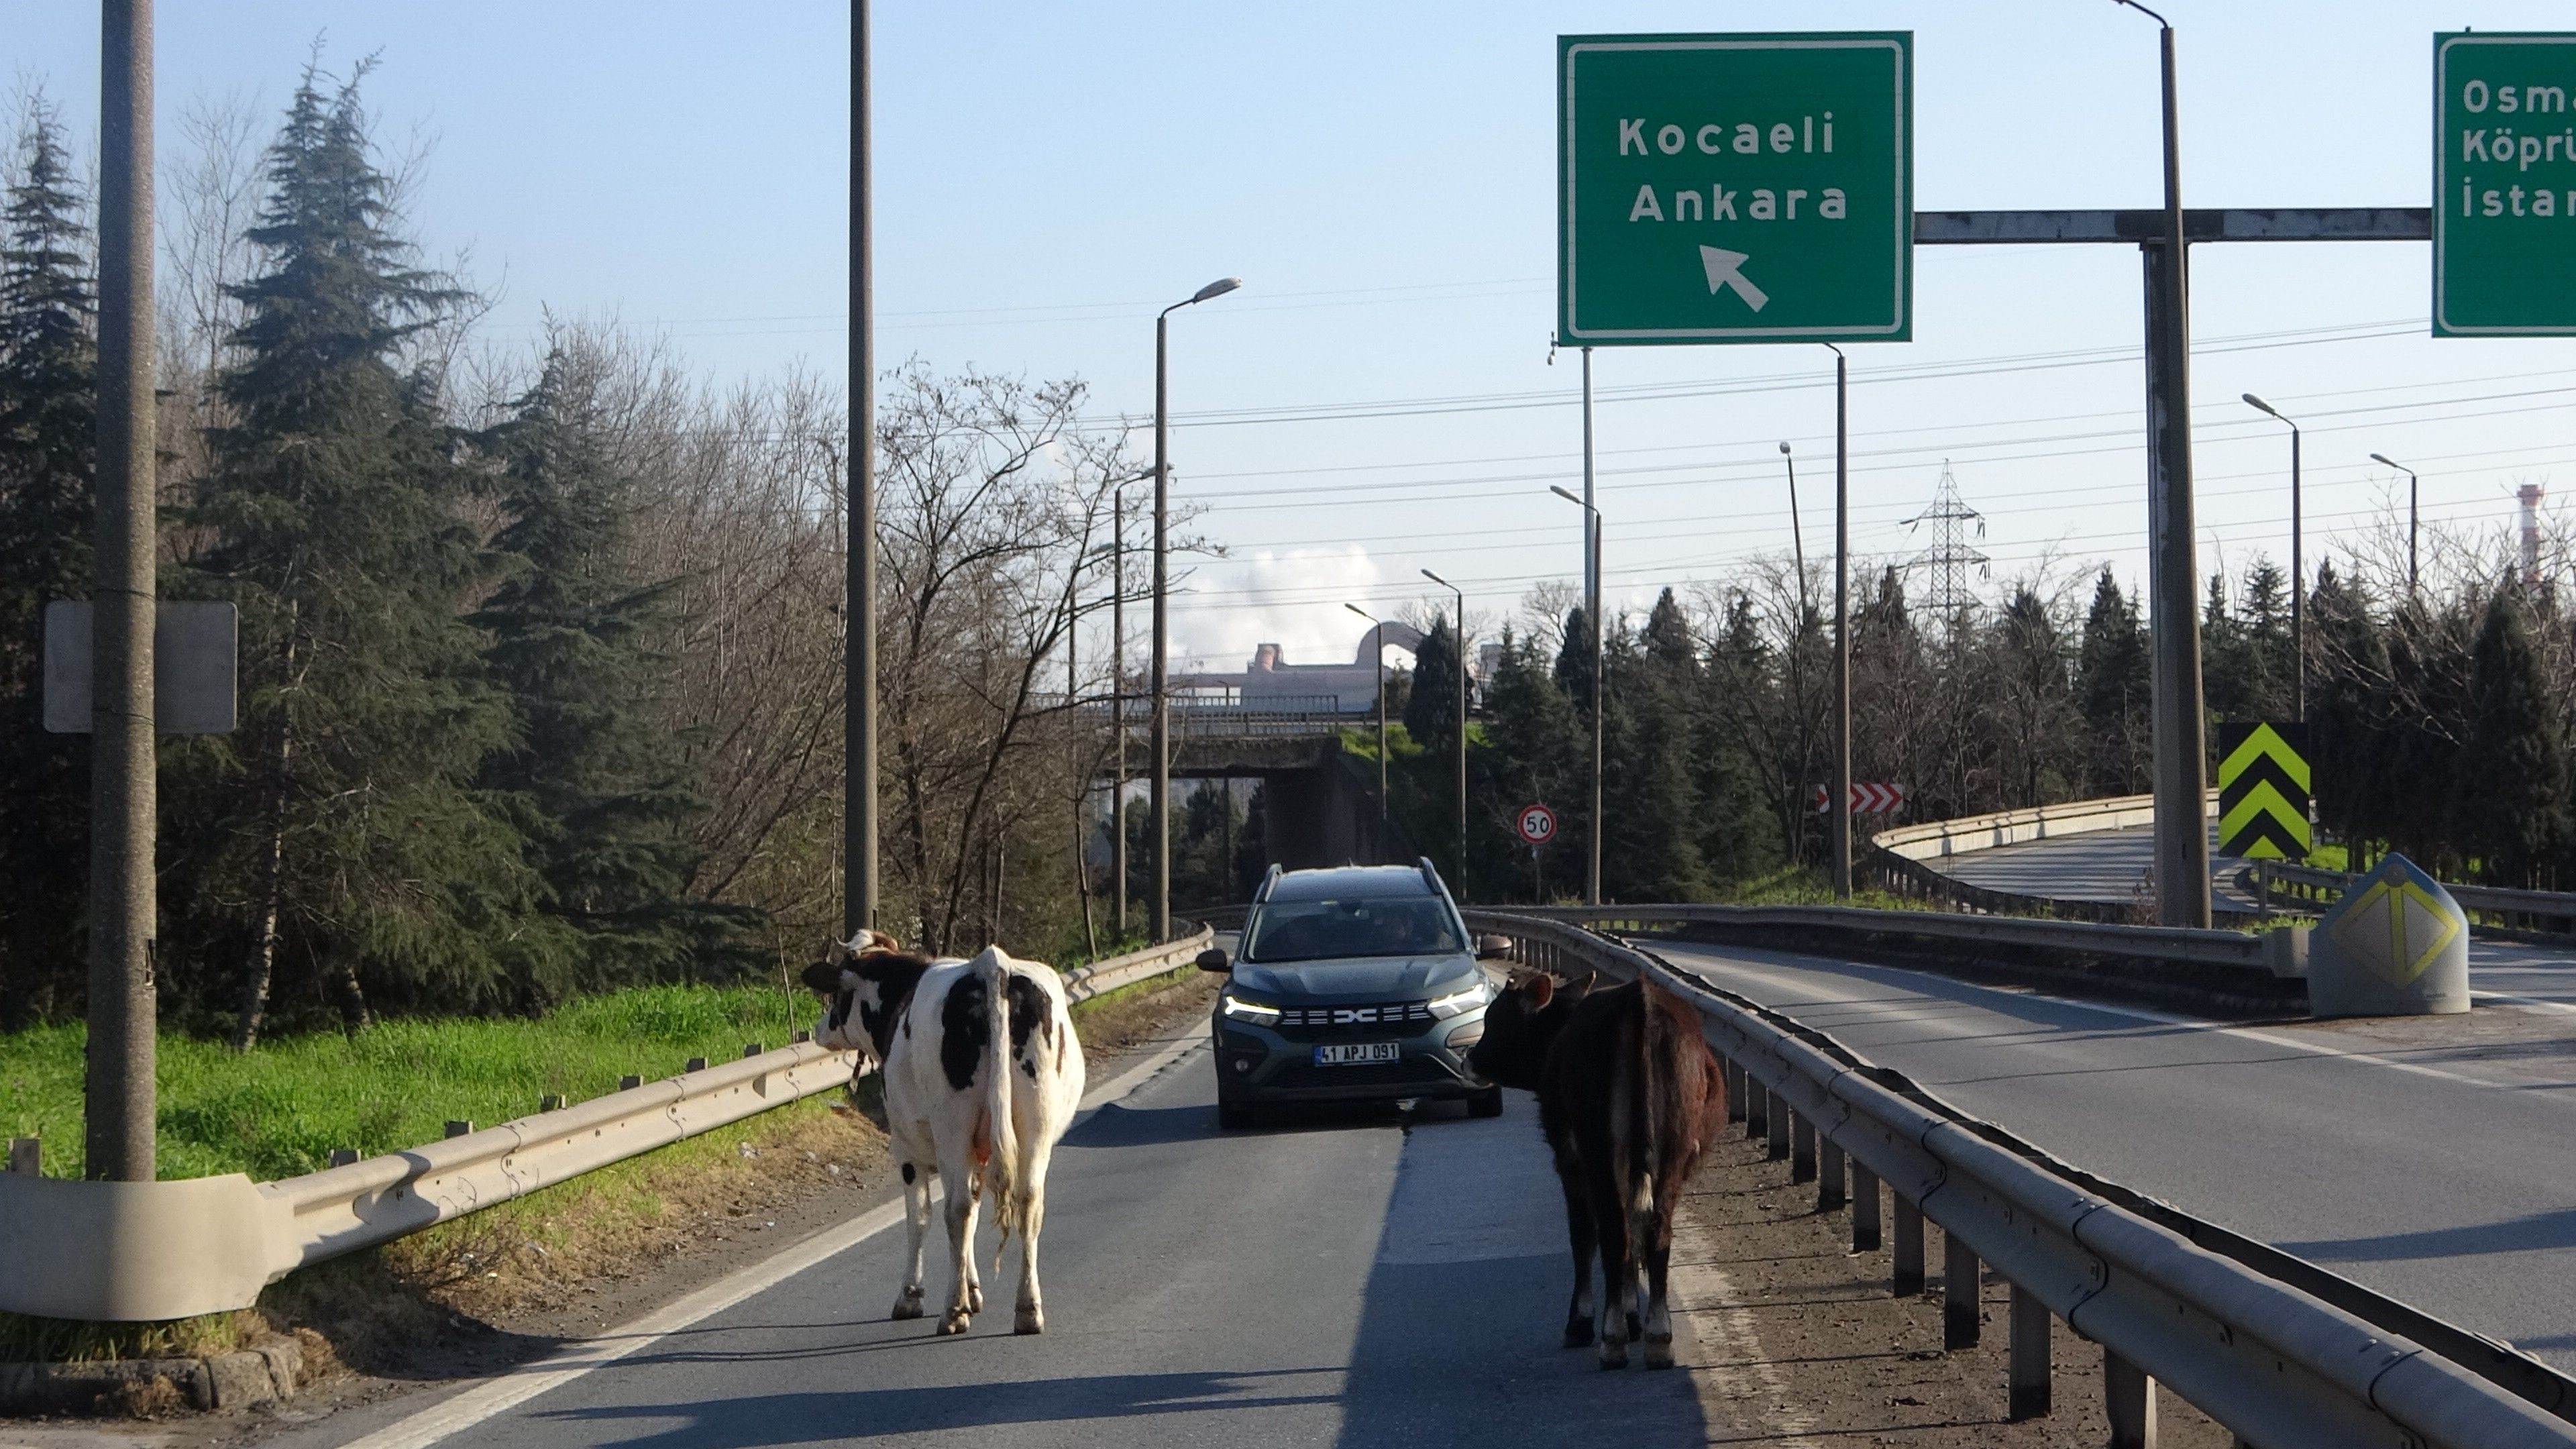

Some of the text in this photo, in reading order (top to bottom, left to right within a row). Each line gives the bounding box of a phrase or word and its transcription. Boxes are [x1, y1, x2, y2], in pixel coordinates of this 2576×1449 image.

[2463, 80, 2576, 113] Osm
[1619, 111, 1833, 156] Kocaeli
[1629, 184, 1846, 222] Ankara
[1527, 816, 1550, 833] 50
[1322, 1044, 1396, 1061] 41 APJ 091
